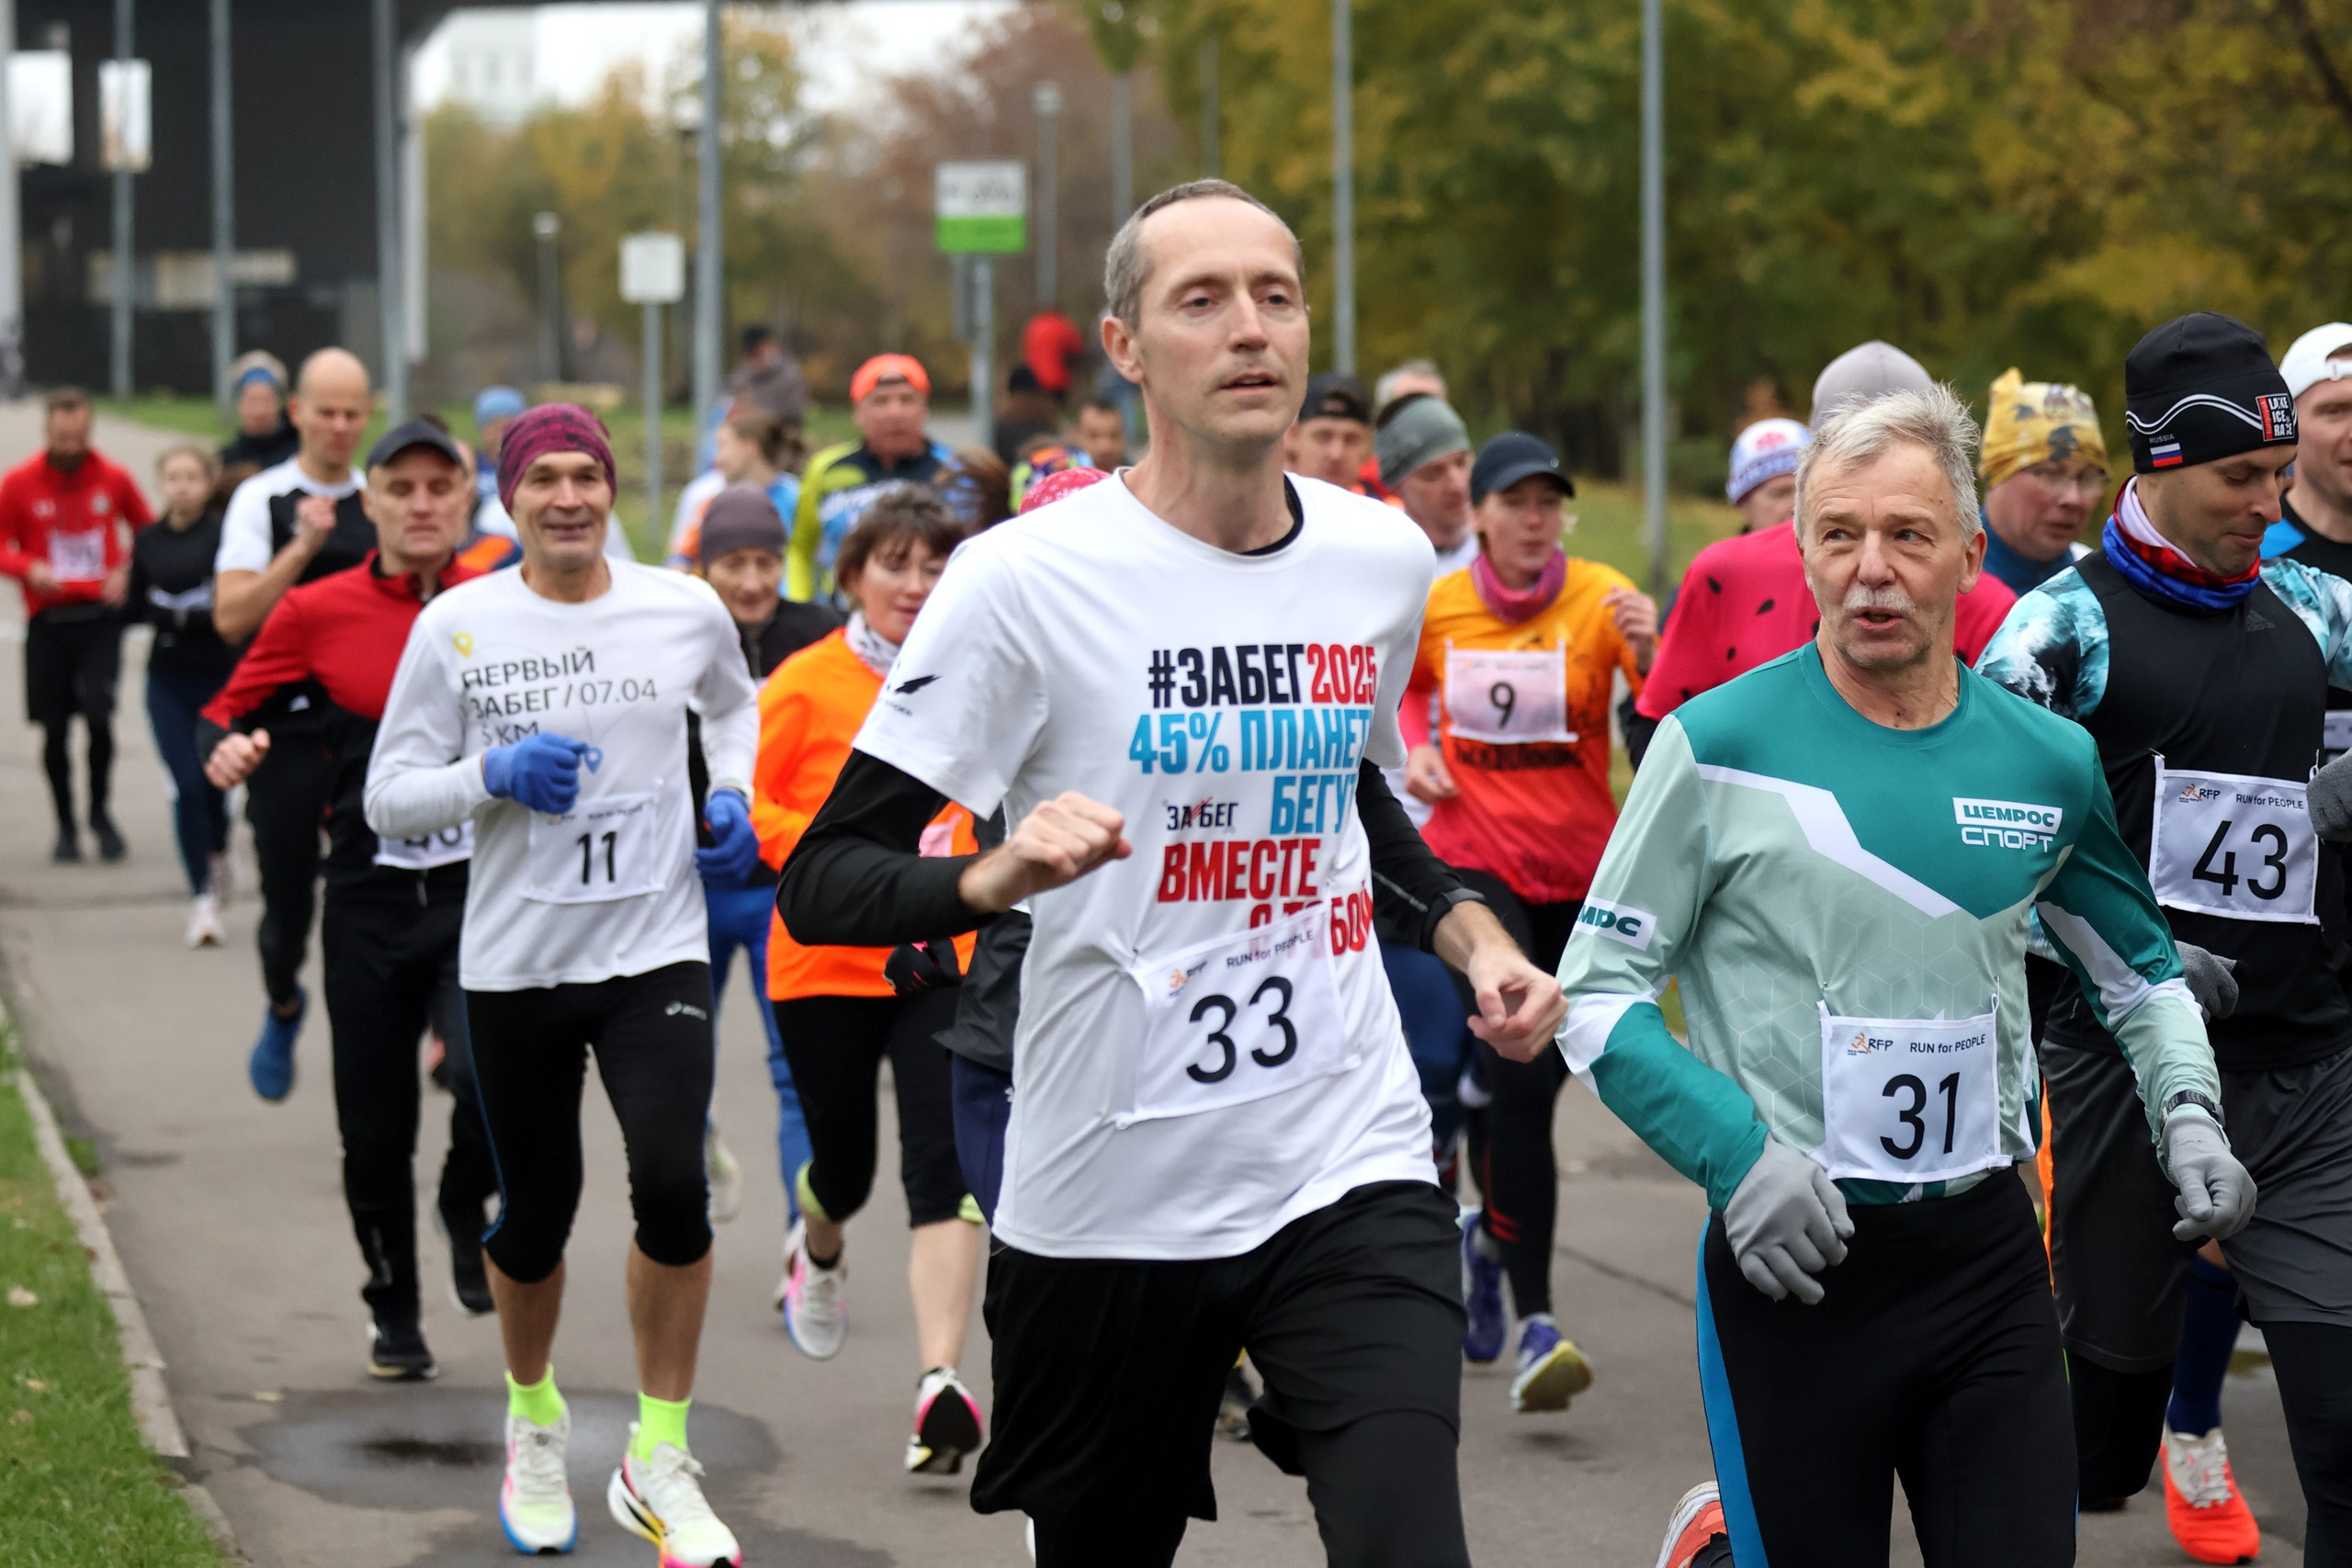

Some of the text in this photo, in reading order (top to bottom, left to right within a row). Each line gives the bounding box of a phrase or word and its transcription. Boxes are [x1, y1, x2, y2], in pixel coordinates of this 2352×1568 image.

[2272, 411, 2286, 423] ICE
[2149, 434, 2175, 444] RUSSIA
[462, 647, 594, 690] ПЕРВЫЙ
[1148, 643, 1377, 708] #ЗАБЕГ2025
[470, 686, 559, 718] ЗАБЕГ
[580, 679, 657, 705] 07.04
[1490, 682, 1515, 728] 9
[1129, 711, 1229, 774] 45%
[1963, 805, 2054, 827] ЦЕМРОС
[2199, 788, 2304, 809] RFP RUN for PEOPLE
[577, 831, 616, 886] 11
[1961, 827, 2053, 853] СПОРТ
[2192, 820, 2288, 900] 43
[1158, 839, 1321, 903] ВМЕСТЕ
[1227, 953, 1252, 968] RUN
[1255, 950, 1272, 962] for
[1274, 931, 1314, 955] PEOPLE
[1186, 976, 1297, 1084] 33
[1868, 1033, 1986, 1054] RFP RUN for PEOPLE
[1880, 1072, 1960, 1159] 31
